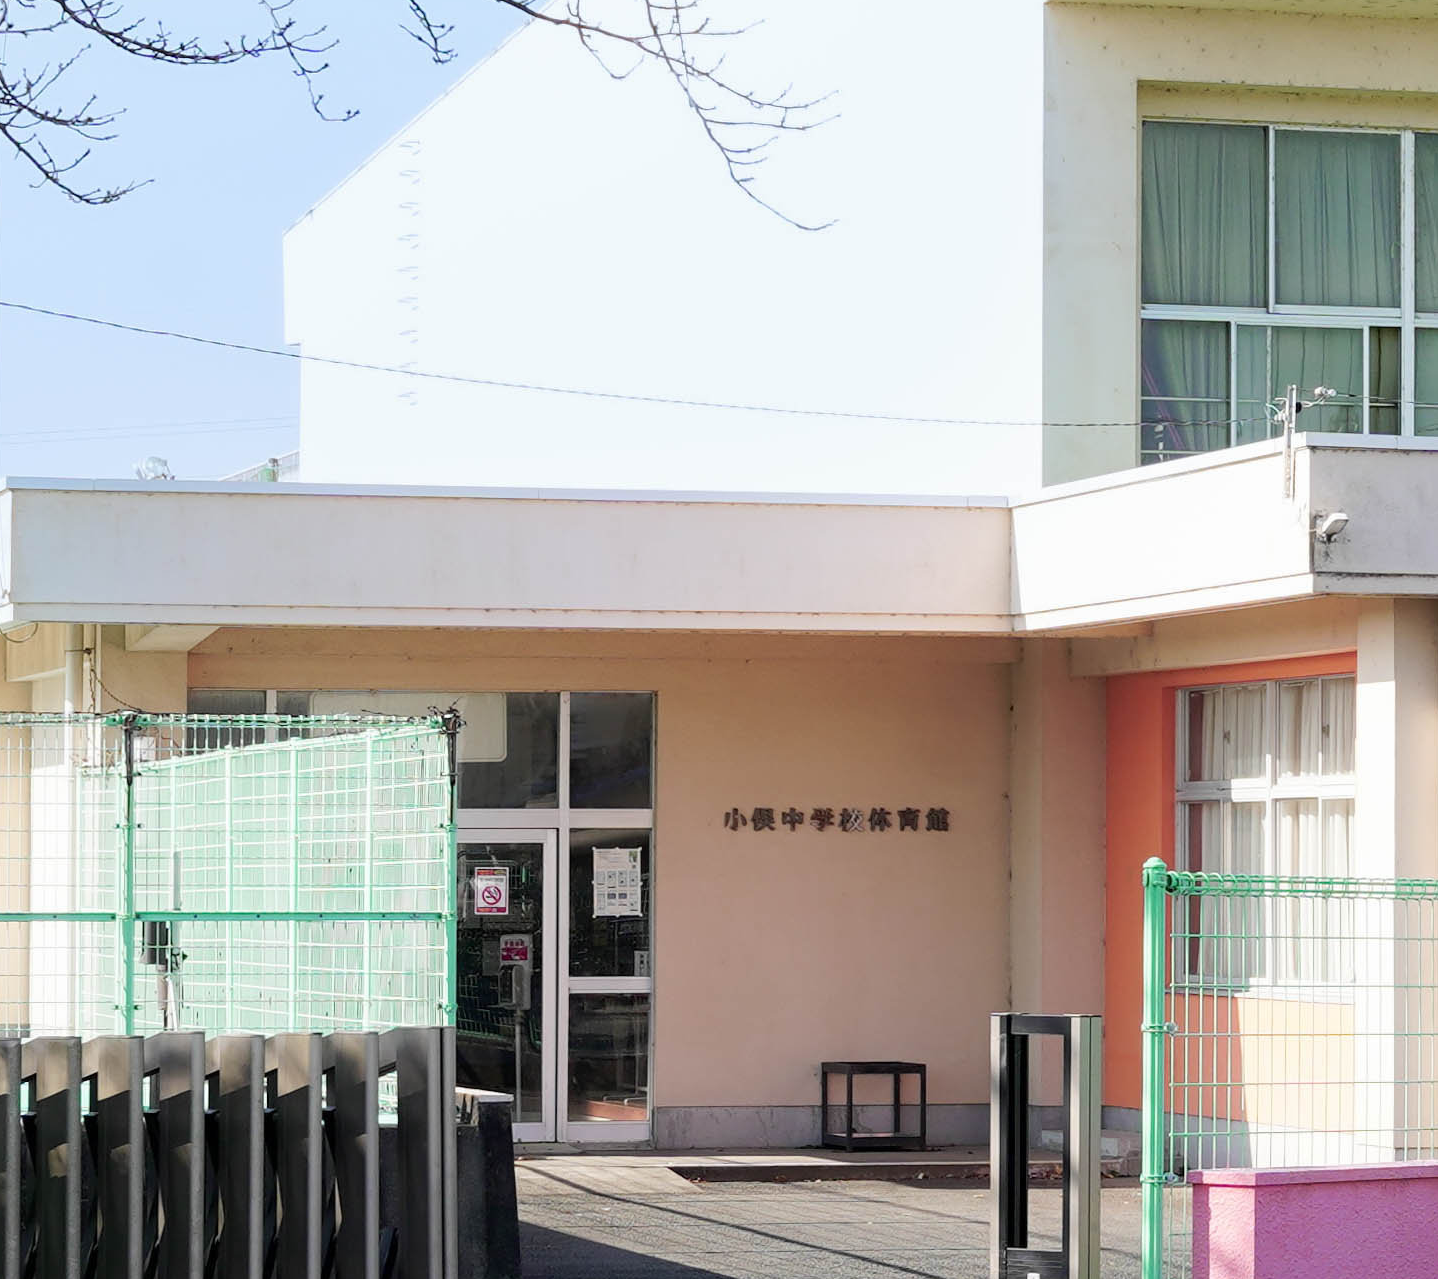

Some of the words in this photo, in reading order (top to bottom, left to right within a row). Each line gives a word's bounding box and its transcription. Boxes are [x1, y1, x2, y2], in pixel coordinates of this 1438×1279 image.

[724, 807, 951, 832] 小俣中学校体育館
